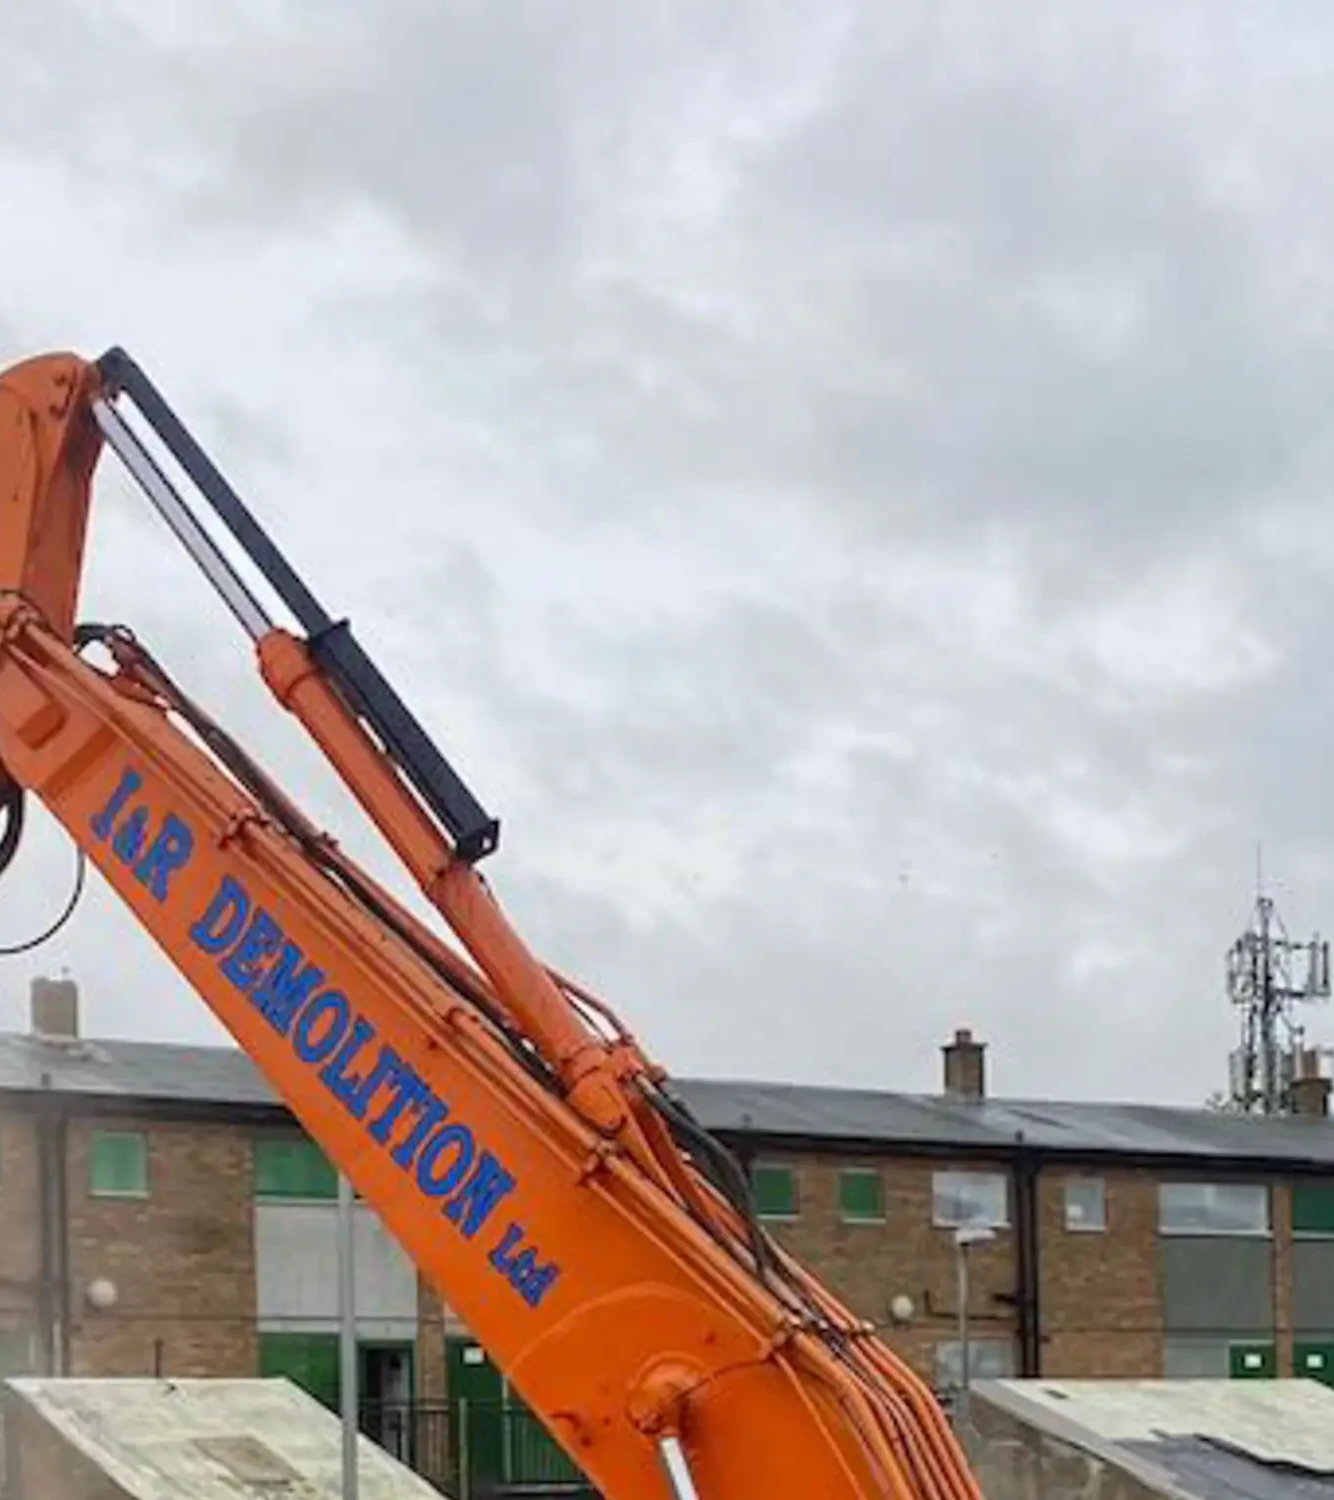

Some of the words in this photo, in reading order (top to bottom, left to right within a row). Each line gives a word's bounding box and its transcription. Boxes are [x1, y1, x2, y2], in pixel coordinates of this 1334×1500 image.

[90, 767, 193, 902] I&R
[190, 876, 517, 1240] DEMOLITION
[487, 1222, 560, 1307] Ltd
